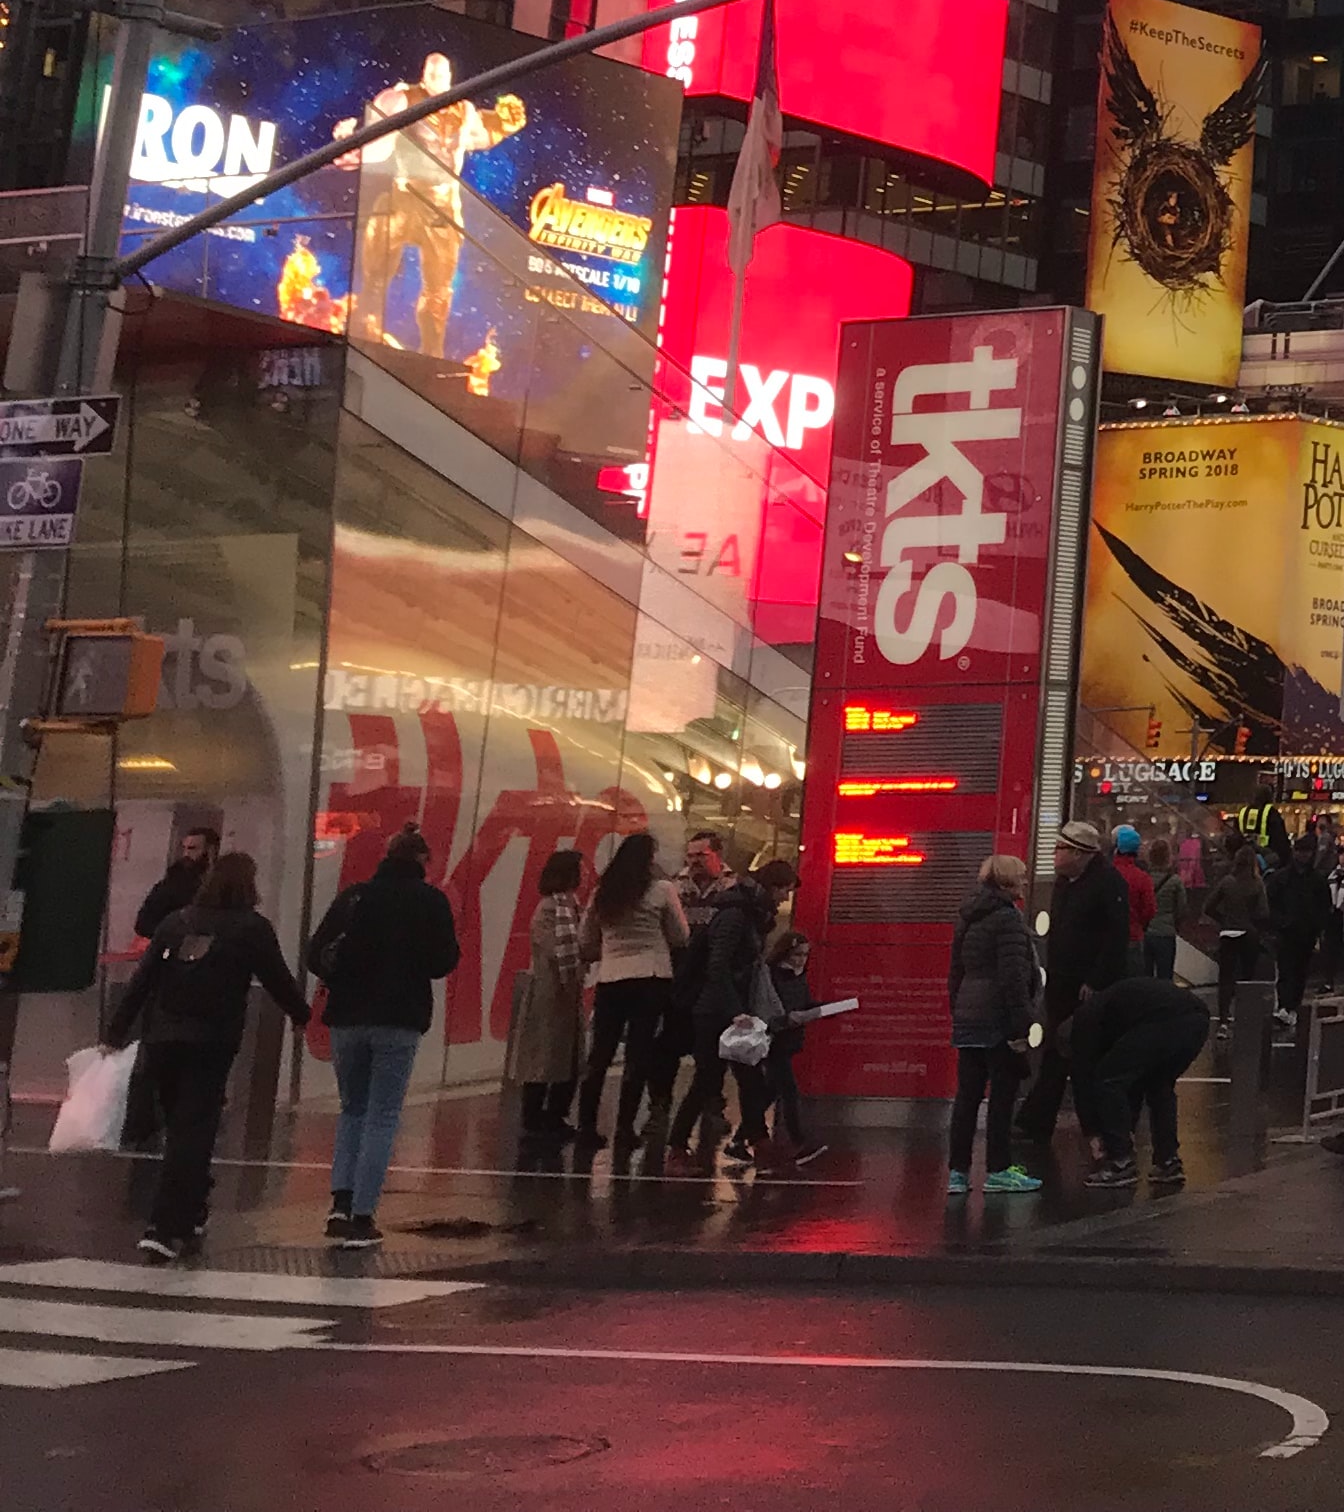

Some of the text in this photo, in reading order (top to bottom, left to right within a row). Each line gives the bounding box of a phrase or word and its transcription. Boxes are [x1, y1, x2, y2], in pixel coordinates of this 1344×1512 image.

[1129, 17, 1246, 62] #KeepTheSecrets
[99, 84, 277, 182] RON
[529, 182, 652, 252] AVENGERS
[55, 415, 97, 439] WAY
[872, 381, 886, 436] service
[870, 439, 881, 456] of
[1142, 447, 1238, 465] BROADWAY
[1138, 463, 1239, 480] SPRING 2018
[873, 345, 1023, 666] tkts
[1125, 497, 1248, 514] HarryPotterThePlay.com
[30, 518, 68, 540] LANE
[856, 521, 877, 622] Development
[853, 625, 868, 665] Fund
